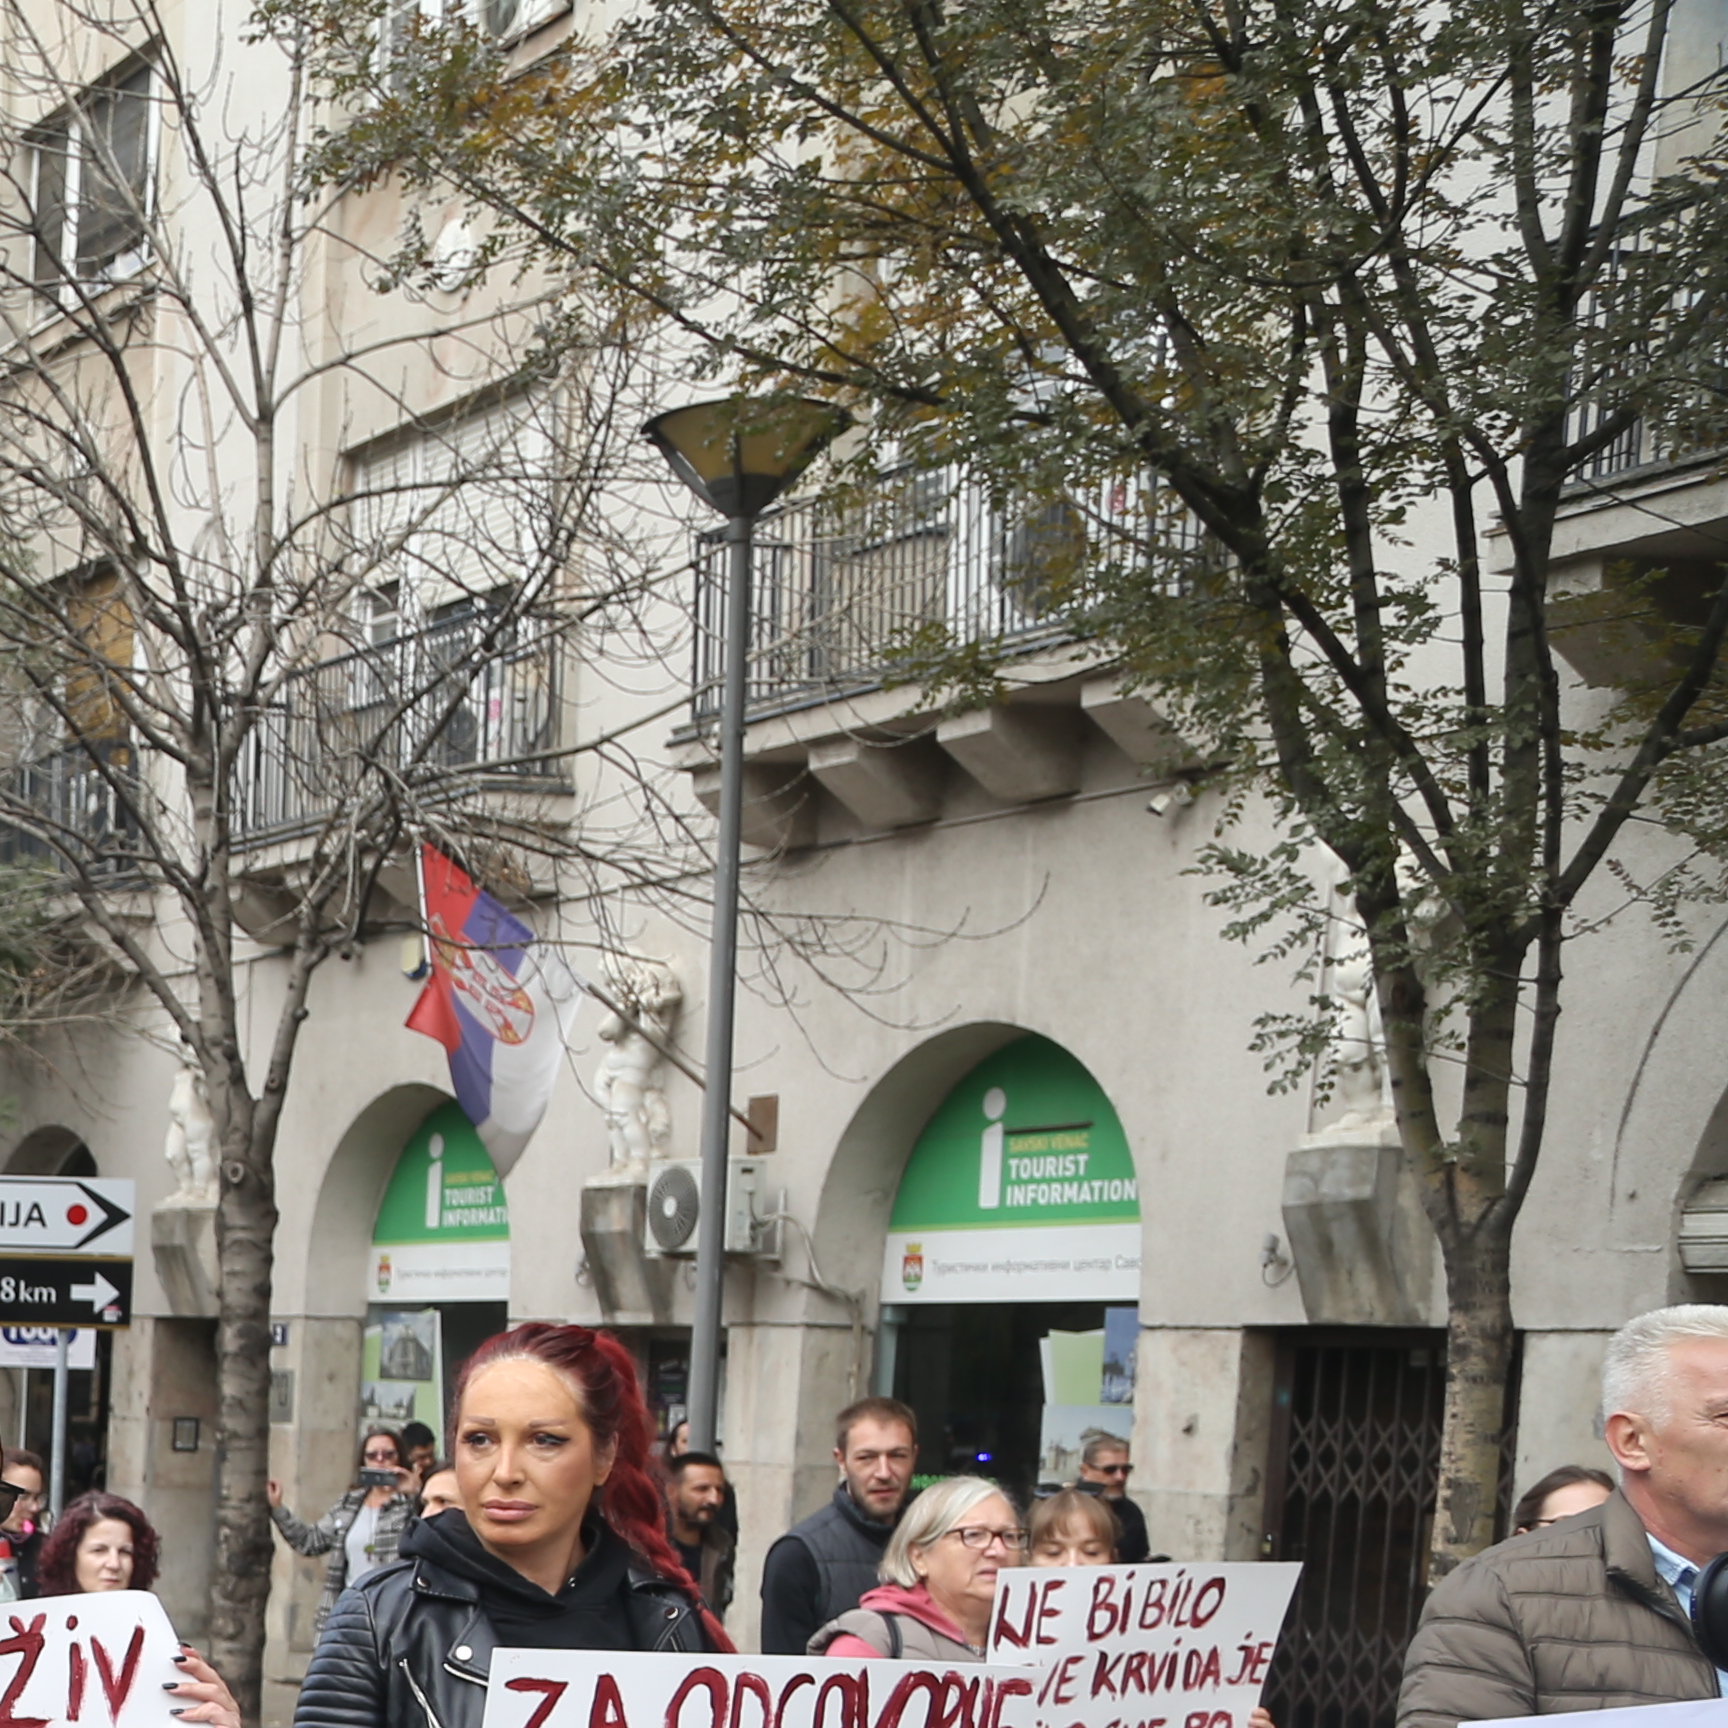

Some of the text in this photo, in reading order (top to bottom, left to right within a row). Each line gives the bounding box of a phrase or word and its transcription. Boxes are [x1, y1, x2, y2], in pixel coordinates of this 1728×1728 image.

[1051, 1133, 1089, 1150] VENAC
[1008, 1153, 1089, 1180] TOURIST
[445, 1185, 493, 1207] TOURIST
[1006, 1178, 1137, 1208] INFORMATION
[19, 1278, 57, 1304] km
[992, 1578, 1067, 1651] NE
